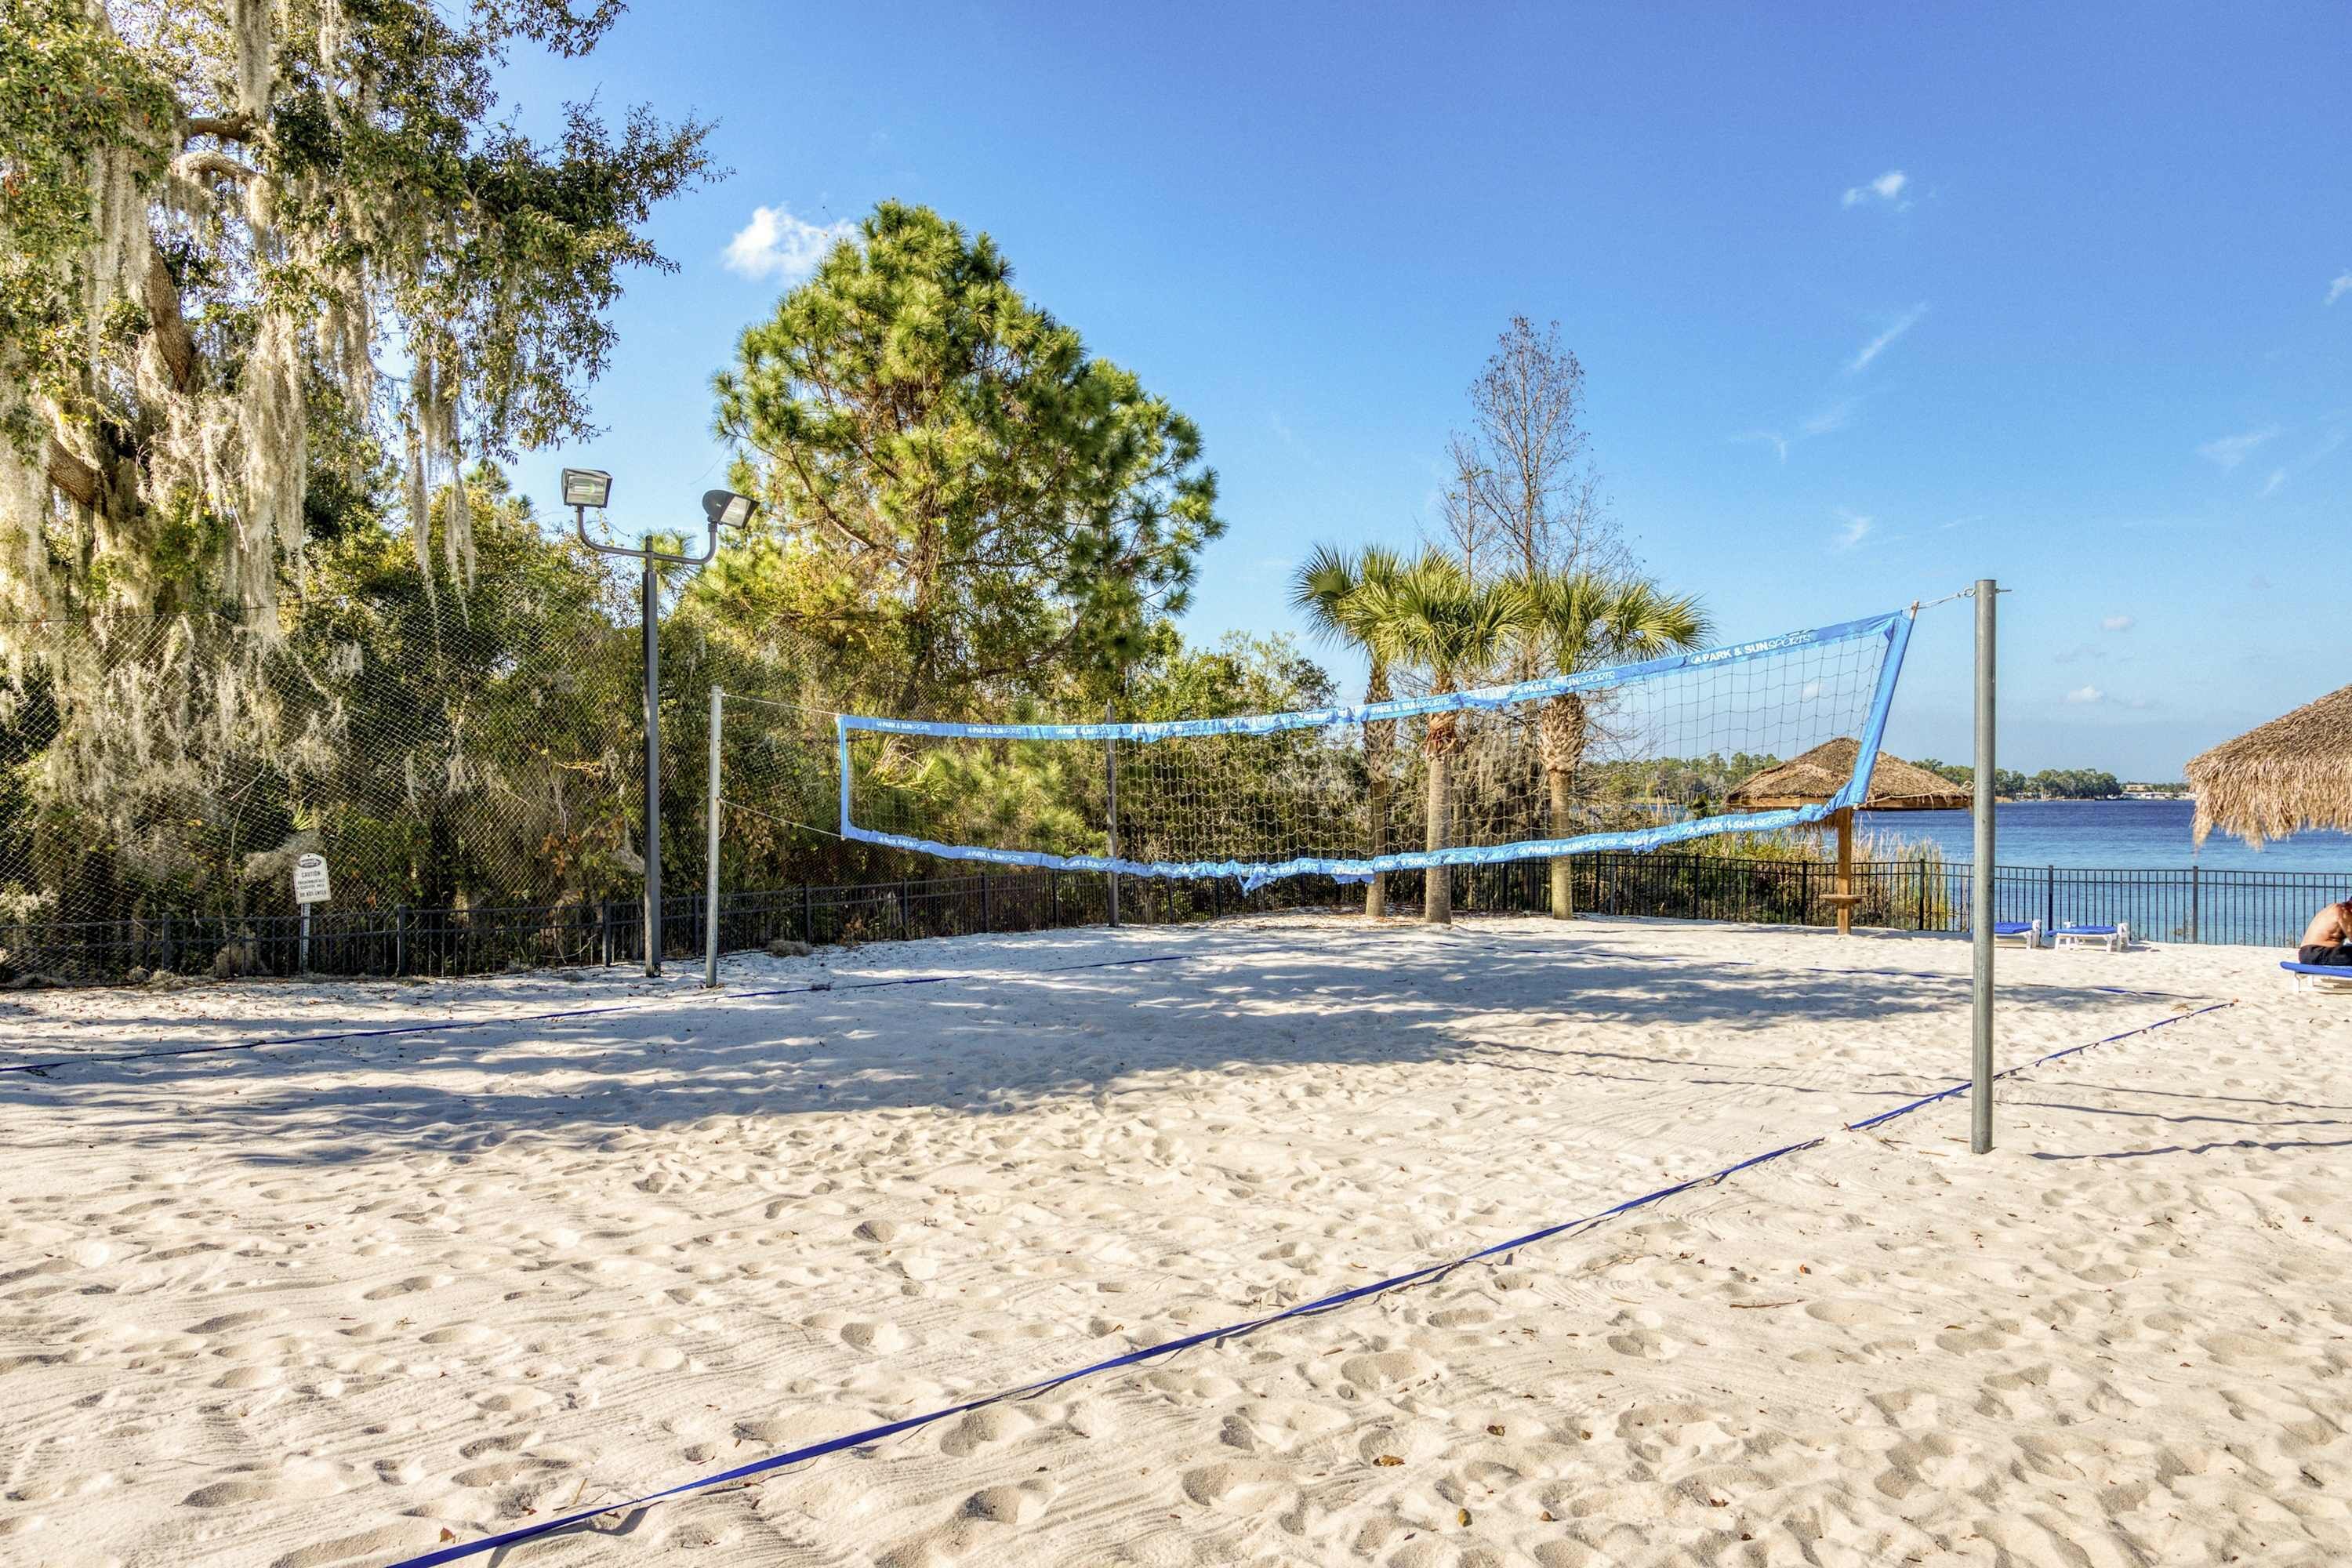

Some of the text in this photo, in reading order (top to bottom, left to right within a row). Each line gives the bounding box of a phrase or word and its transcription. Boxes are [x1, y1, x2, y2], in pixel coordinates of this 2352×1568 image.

[1702, 651, 1733, 663] PARK
[1733, 648, 1743, 656] &
[1523, 681, 1549, 691] PARK
[1372, 705, 1393, 715] PARK
[1697, 822, 1723, 833] PARK
[1529, 845, 1552, 855] PARK
